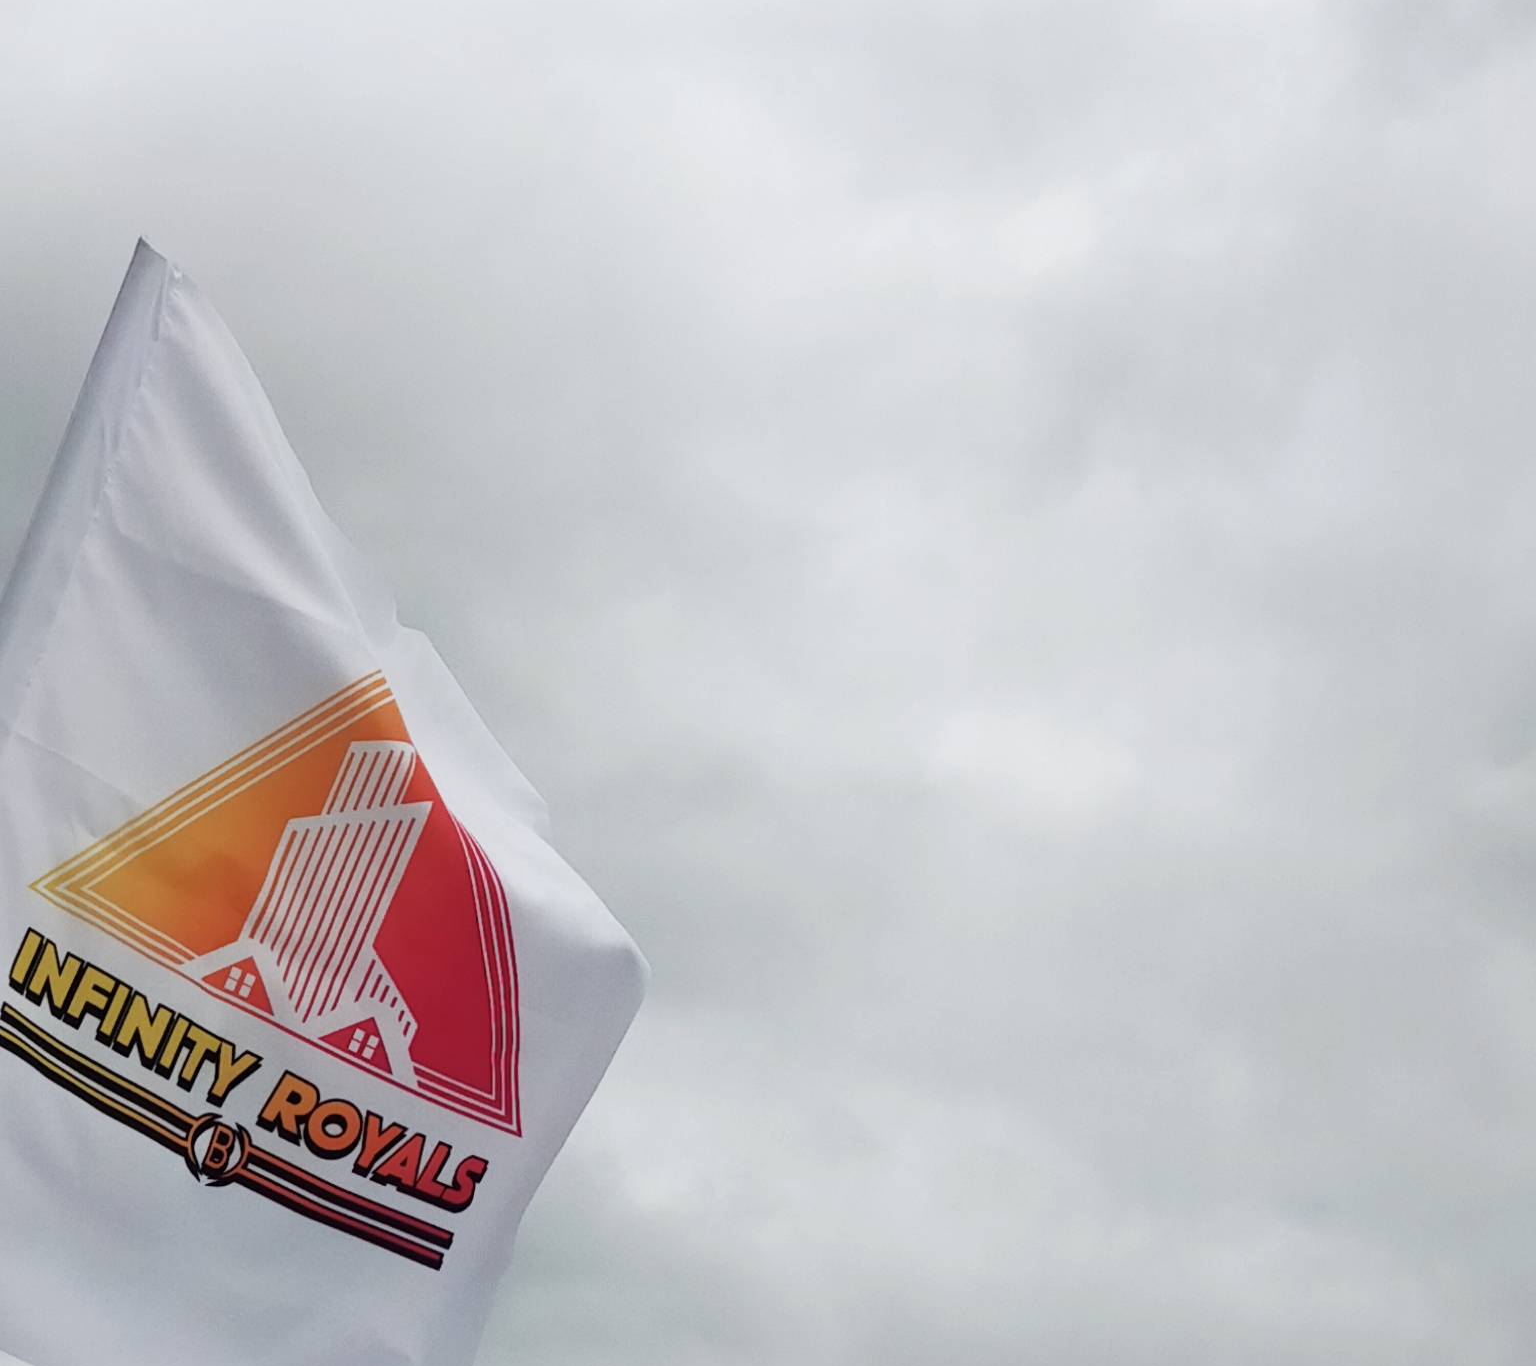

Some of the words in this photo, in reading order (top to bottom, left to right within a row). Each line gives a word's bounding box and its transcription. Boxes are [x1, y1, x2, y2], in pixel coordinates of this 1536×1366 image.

[9, 927, 263, 1107] INFINITY
[256, 1070, 489, 1213] ROYALS
[202, 1122, 236, 1175] B
